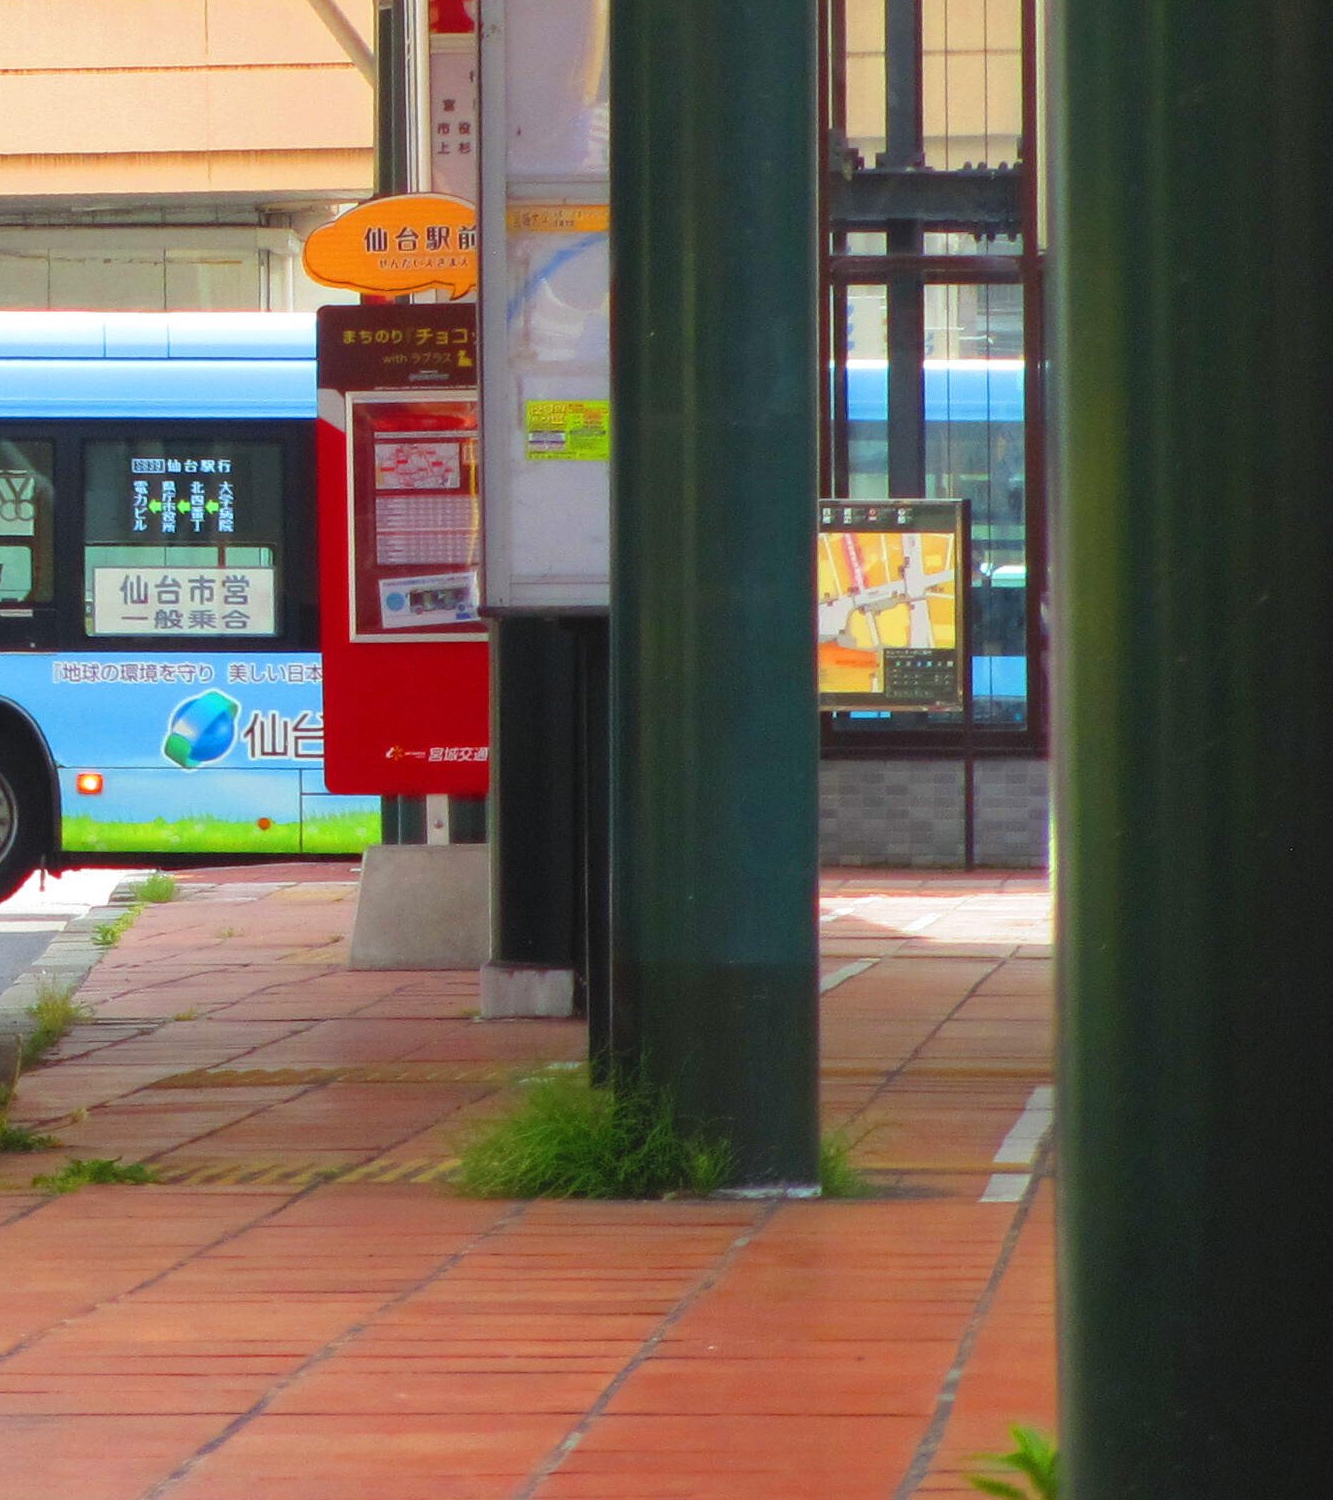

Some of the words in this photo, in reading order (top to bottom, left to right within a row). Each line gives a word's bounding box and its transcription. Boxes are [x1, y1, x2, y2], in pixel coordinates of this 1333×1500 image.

[364, 225, 477, 252] 仙台駅前
[119, 574, 251, 606] 仙台市営
[121, 608, 251, 630] 一般乗合
